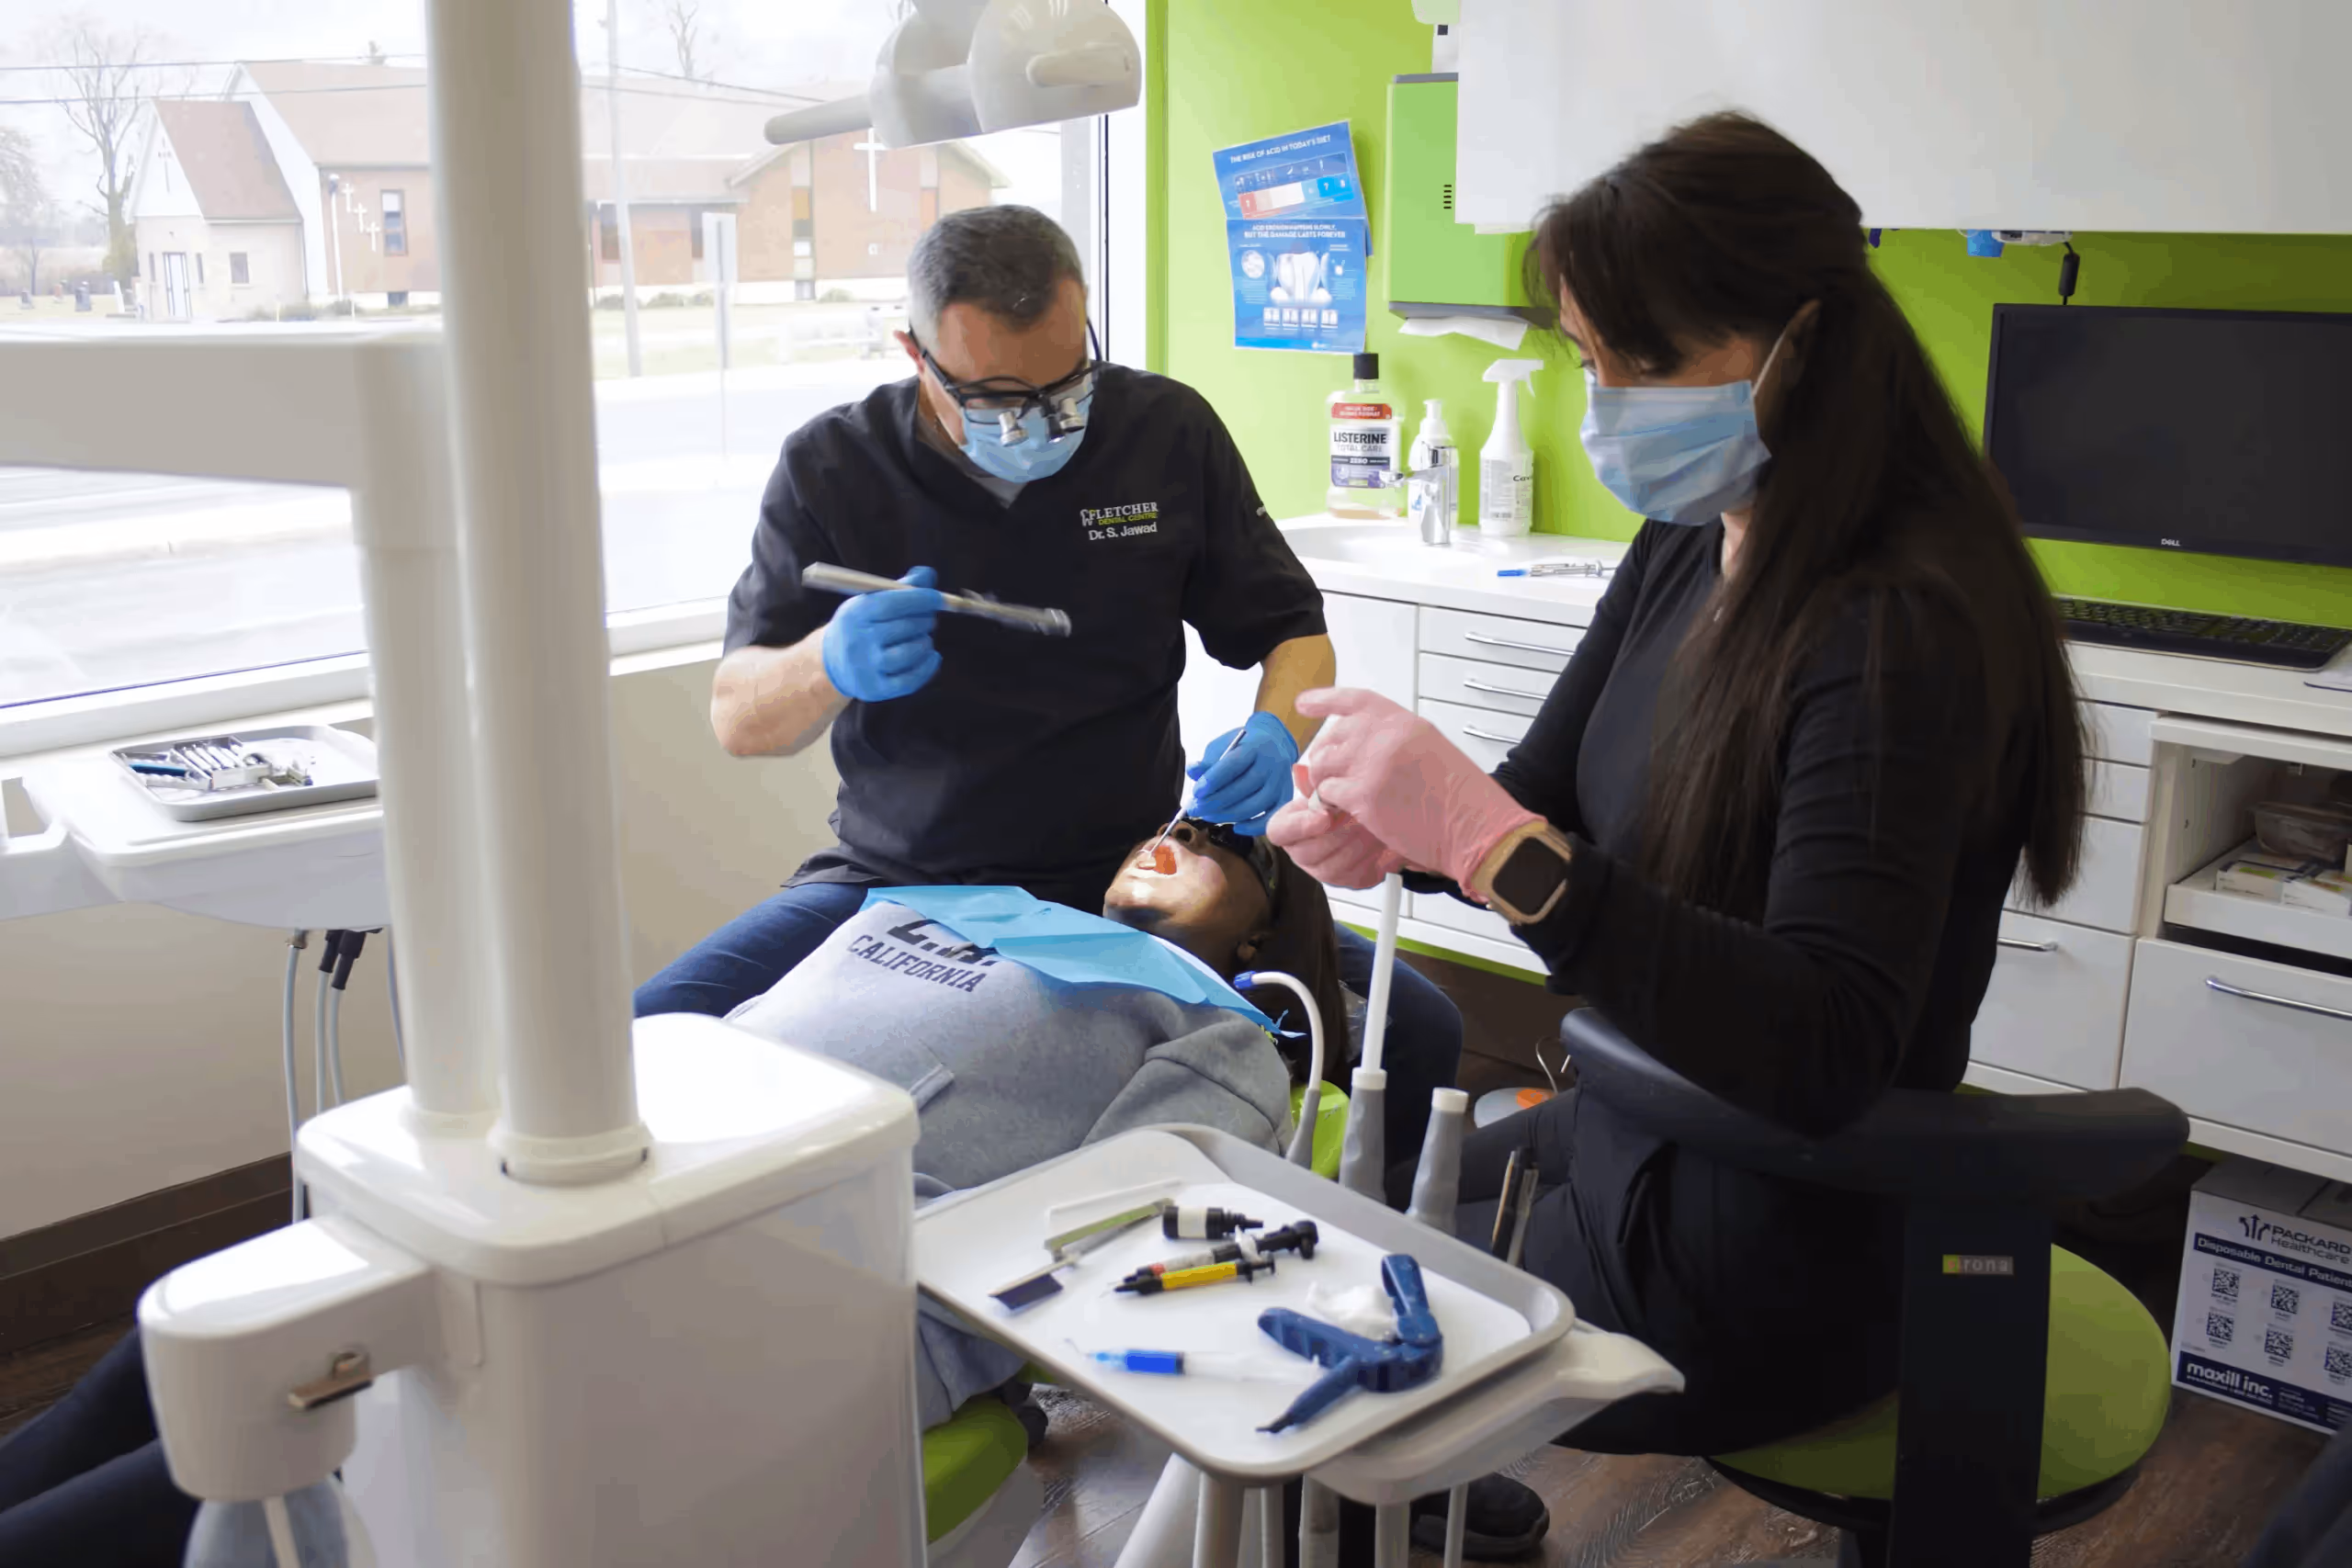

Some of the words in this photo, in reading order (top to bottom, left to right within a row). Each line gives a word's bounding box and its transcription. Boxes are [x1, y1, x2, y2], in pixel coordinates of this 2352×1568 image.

[1230, 155, 1242, 164] THE
[1266, 146, 1282, 155] ACID
[1289, 139, 1316, 151] TODAY'S
[1316, 134, 1331, 145] DIET
[1317, 231, 1346, 239] FOREVER
[1333, 432, 1387, 444] LISTERINE
[1338, 444, 1360, 452] TOTAL
[1361, 445, 1383, 453] CARE
[1089, 502, 1159, 520] FLETCHER
[1098, 516, 1127, 525] DENTAL
[1128, 512, 1158, 522] CENTRE
[1088, 529, 1105, 541] Dr.
[1105, 526, 1119, 538] S.
[1121, 522, 1158, 536] Jawad
[2161, 538, 2180, 547] DELL
[846, 934, 988, 993] CALIFORNIA
[2271, 1224, 2351, 1255] PACKARD
[2198, 1237, 2262, 1263] Disposable
[2264, 1256, 2305, 1275] Dental
[2270, 1236, 2350, 1264] Healthcare
[2187, 1362, 2240, 1387] maxill
[2243, 1376, 2274, 1399] inc.
